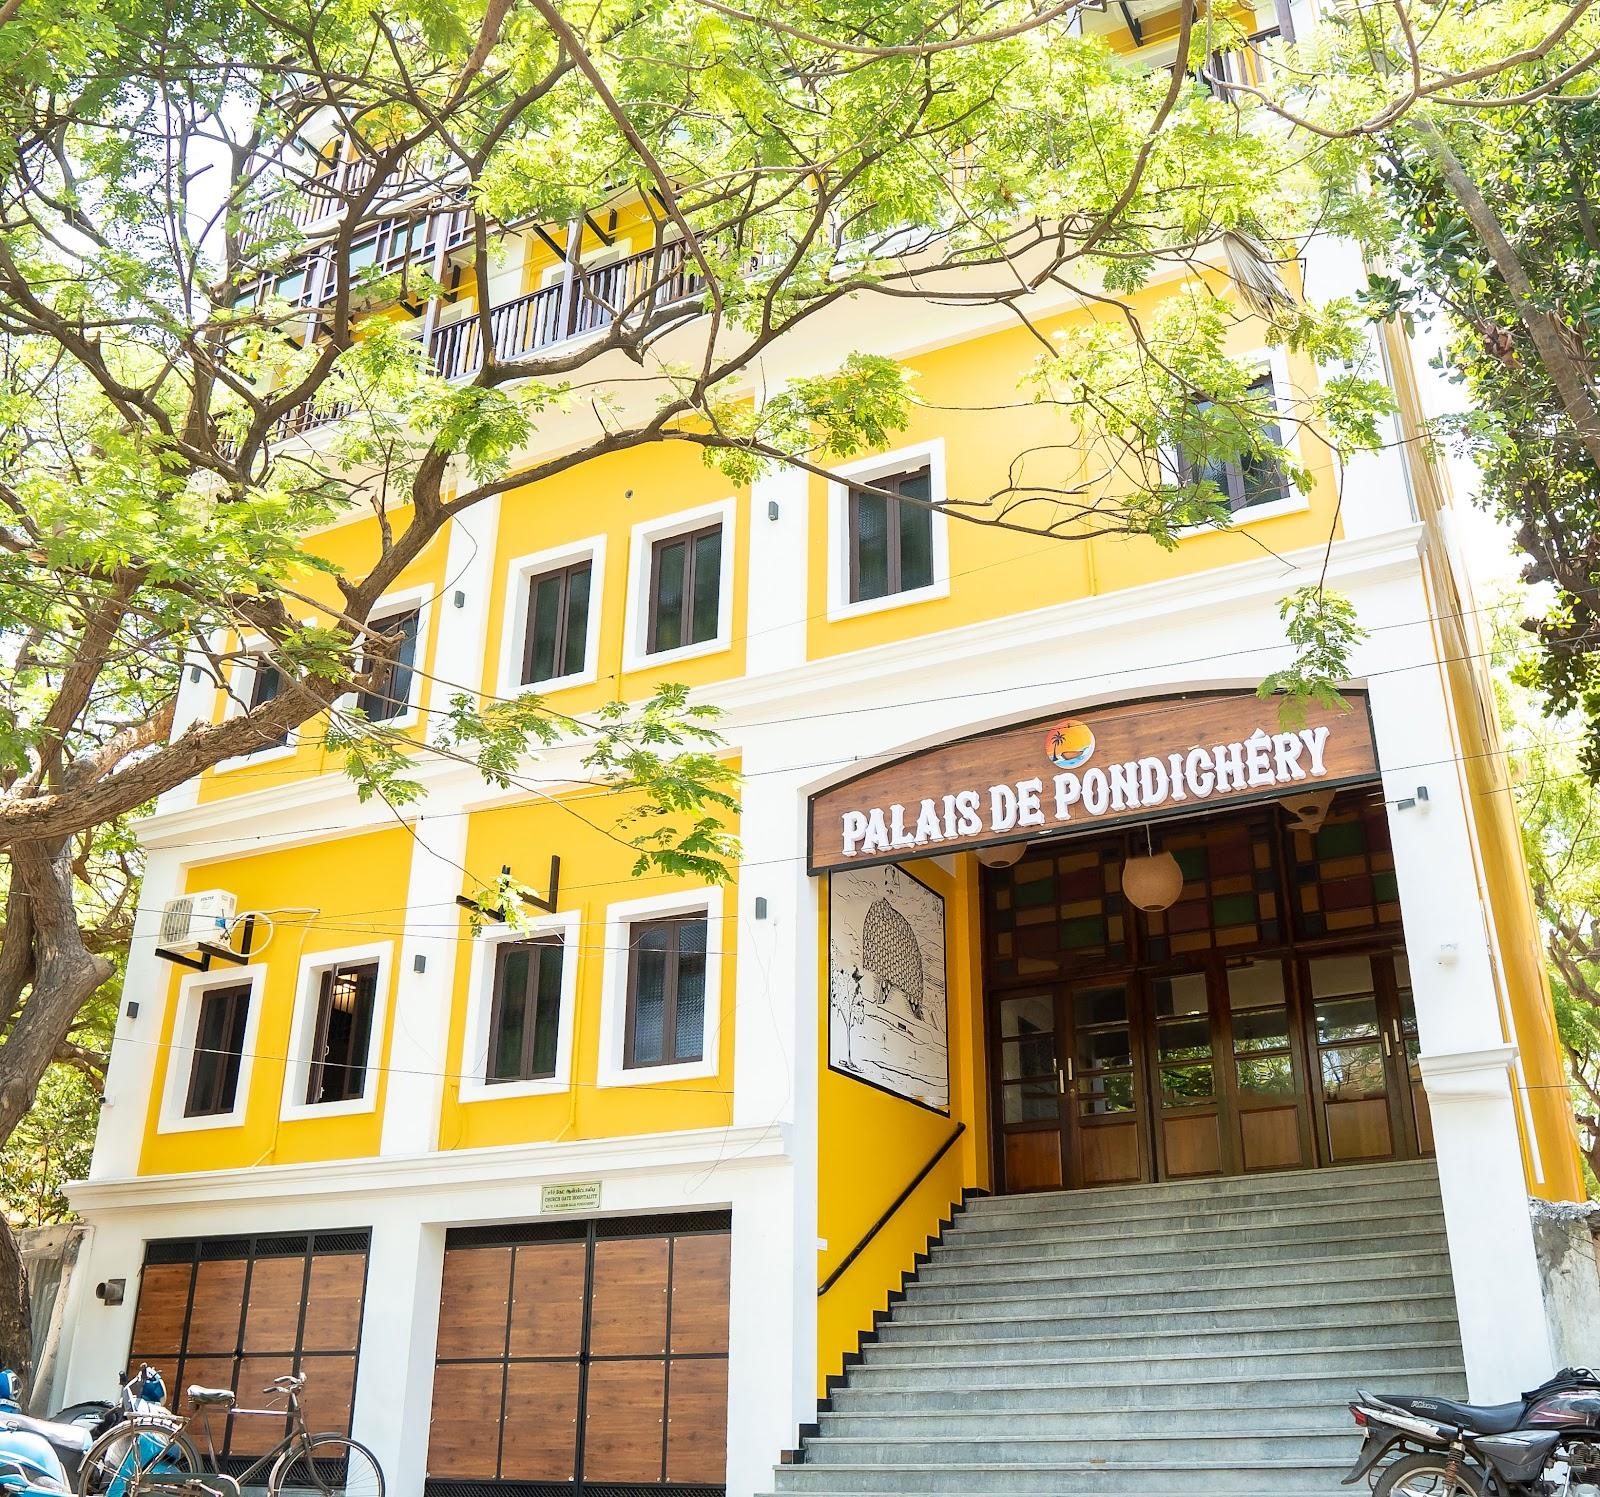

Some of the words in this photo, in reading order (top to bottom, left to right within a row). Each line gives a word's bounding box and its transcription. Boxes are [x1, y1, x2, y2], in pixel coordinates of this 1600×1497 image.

[841, 790, 983, 857] PALAIS
[989, 777, 1045, 834] DE
[1053, 727, 1331, 821] PONDICHÉRY
